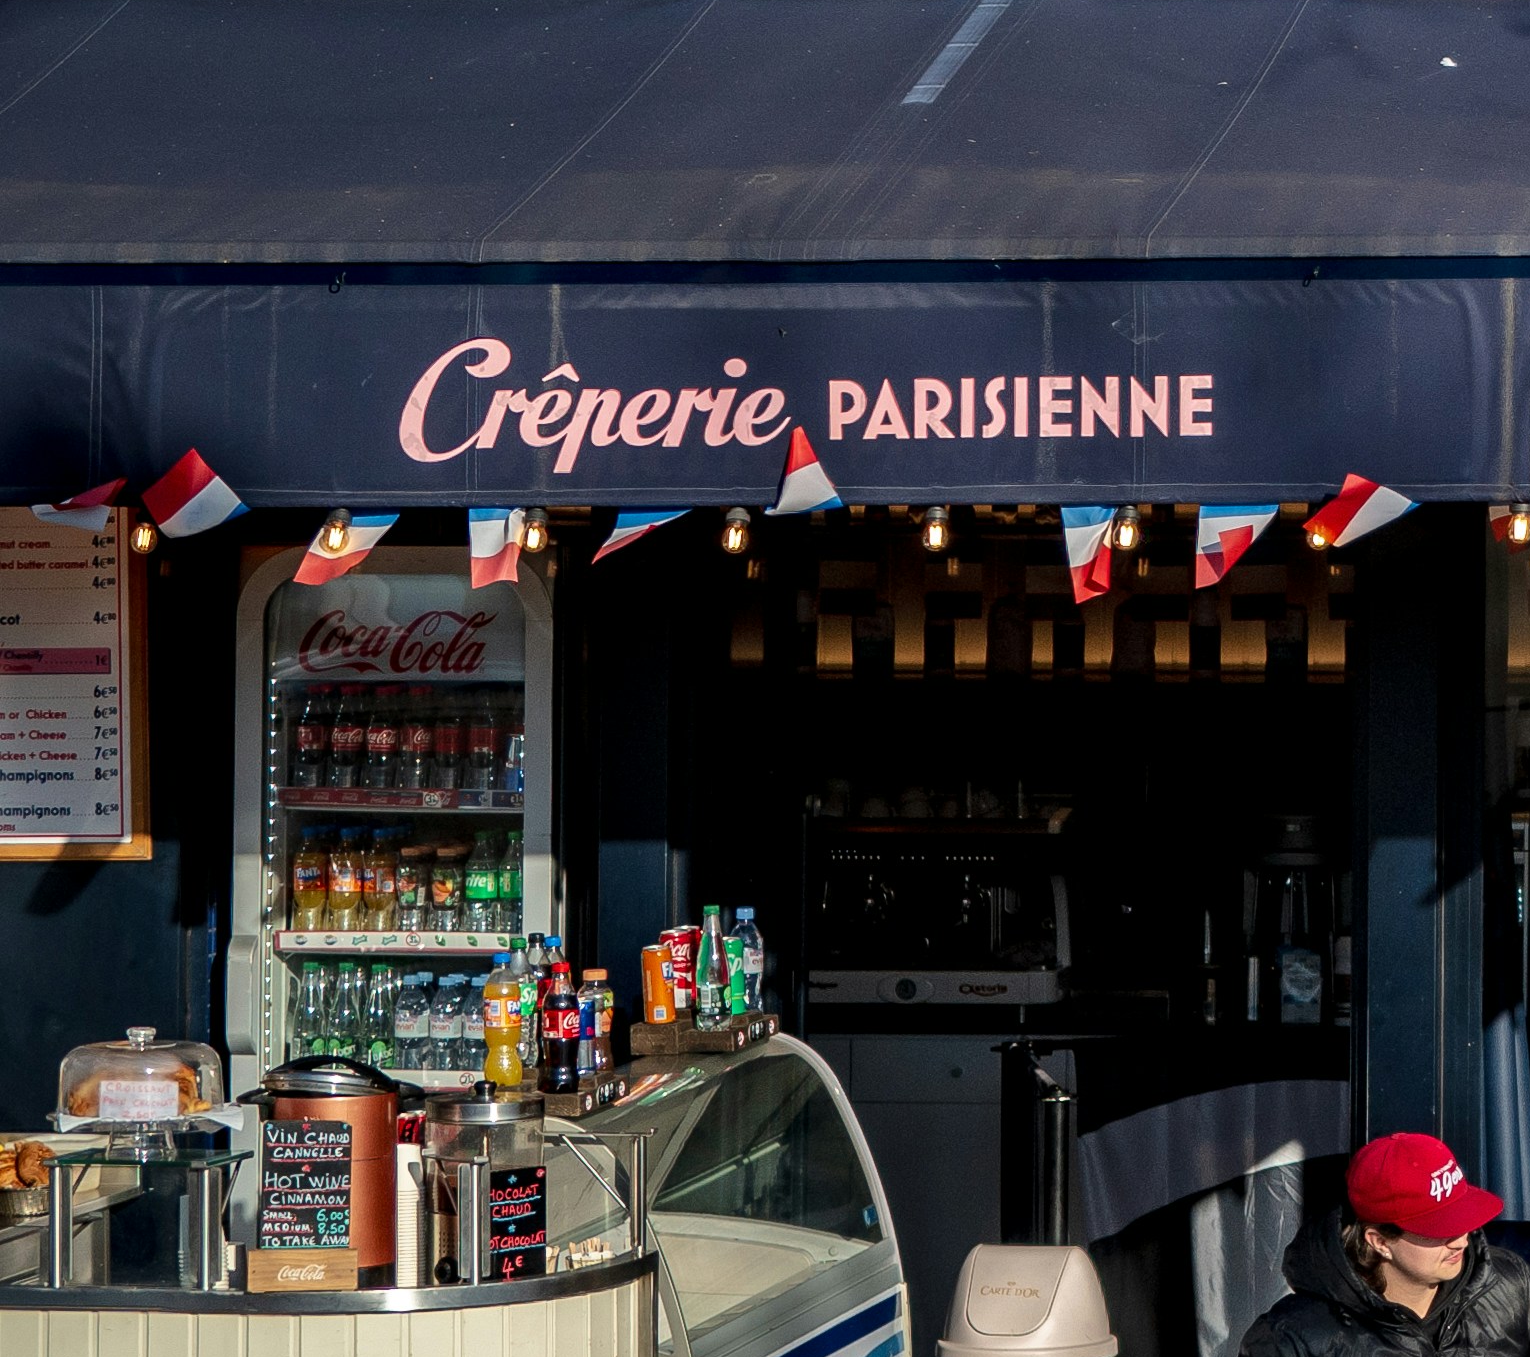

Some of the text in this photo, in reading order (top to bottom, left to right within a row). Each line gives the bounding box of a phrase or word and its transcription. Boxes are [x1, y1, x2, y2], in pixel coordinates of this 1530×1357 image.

[399, 337, 1214, 474] Crêperie PARISIENNE
[17, 559, 46, 570] butter
[50, 559, 88, 570] caramel
[298, 610, 498, 674] Coca-Cola
[26, 709, 67, 719] Chicken
[29, 730, 67, 740] Cheese
[39, 750, 77, 760] Cheese
[465, 873, 488, 888] rite
[267, 1130, 349, 1144] VIN CHAUD
[273, 1147, 344, 1158] CANNELLE
[265, 1172, 350, 1190] HOT WINE
[270, 1193, 346, 1205] CINNAMON
[490, 1185, 539, 1202] HOCOLAT
[492, 1204, 532, 1218] CHAUD
[262, 1236, 280, 1247] TO
[283, 1236, 315, 1247] TAKE
[980, 1285, 1011, 1296] CARTE
